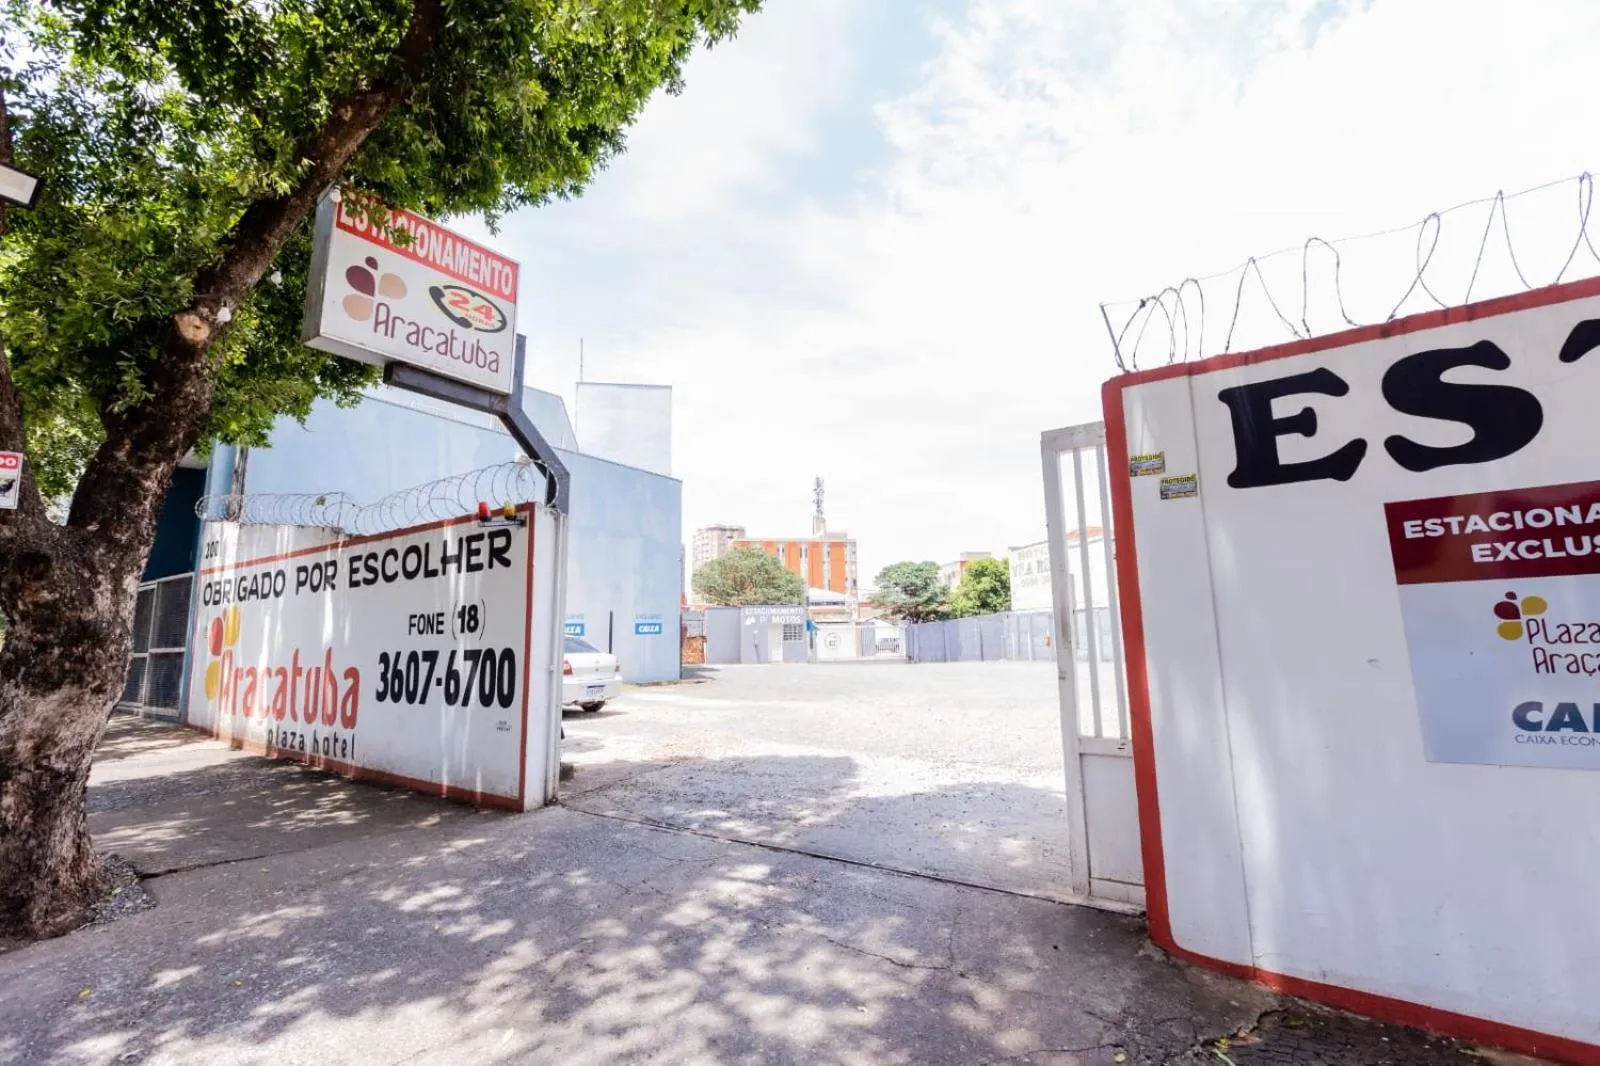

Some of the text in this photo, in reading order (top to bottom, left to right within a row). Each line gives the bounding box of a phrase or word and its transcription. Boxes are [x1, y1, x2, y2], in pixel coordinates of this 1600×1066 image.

[448, 290, 495, 321] 24
[373, 302, 500, 374] Araçatuba
[1403, 502, 1600, 540] ESTACIONA
[203, 528, 512, 607] OBRIGADO POR ESCOLHER
[408, 599, 486, 641] FONE (18)
[638, 625, 660, 633] CAIXA
[771, 615, 802, 624] MOTOS
[1526, 617, 1600, 645] Plaza
[376, 647, 516, 709] 3607-6700
[1532, 646, 1600, 677] Araç
[268, 725, 355, 761] plaza hotel
[1514, 734, 1558, 745] CAIXA
